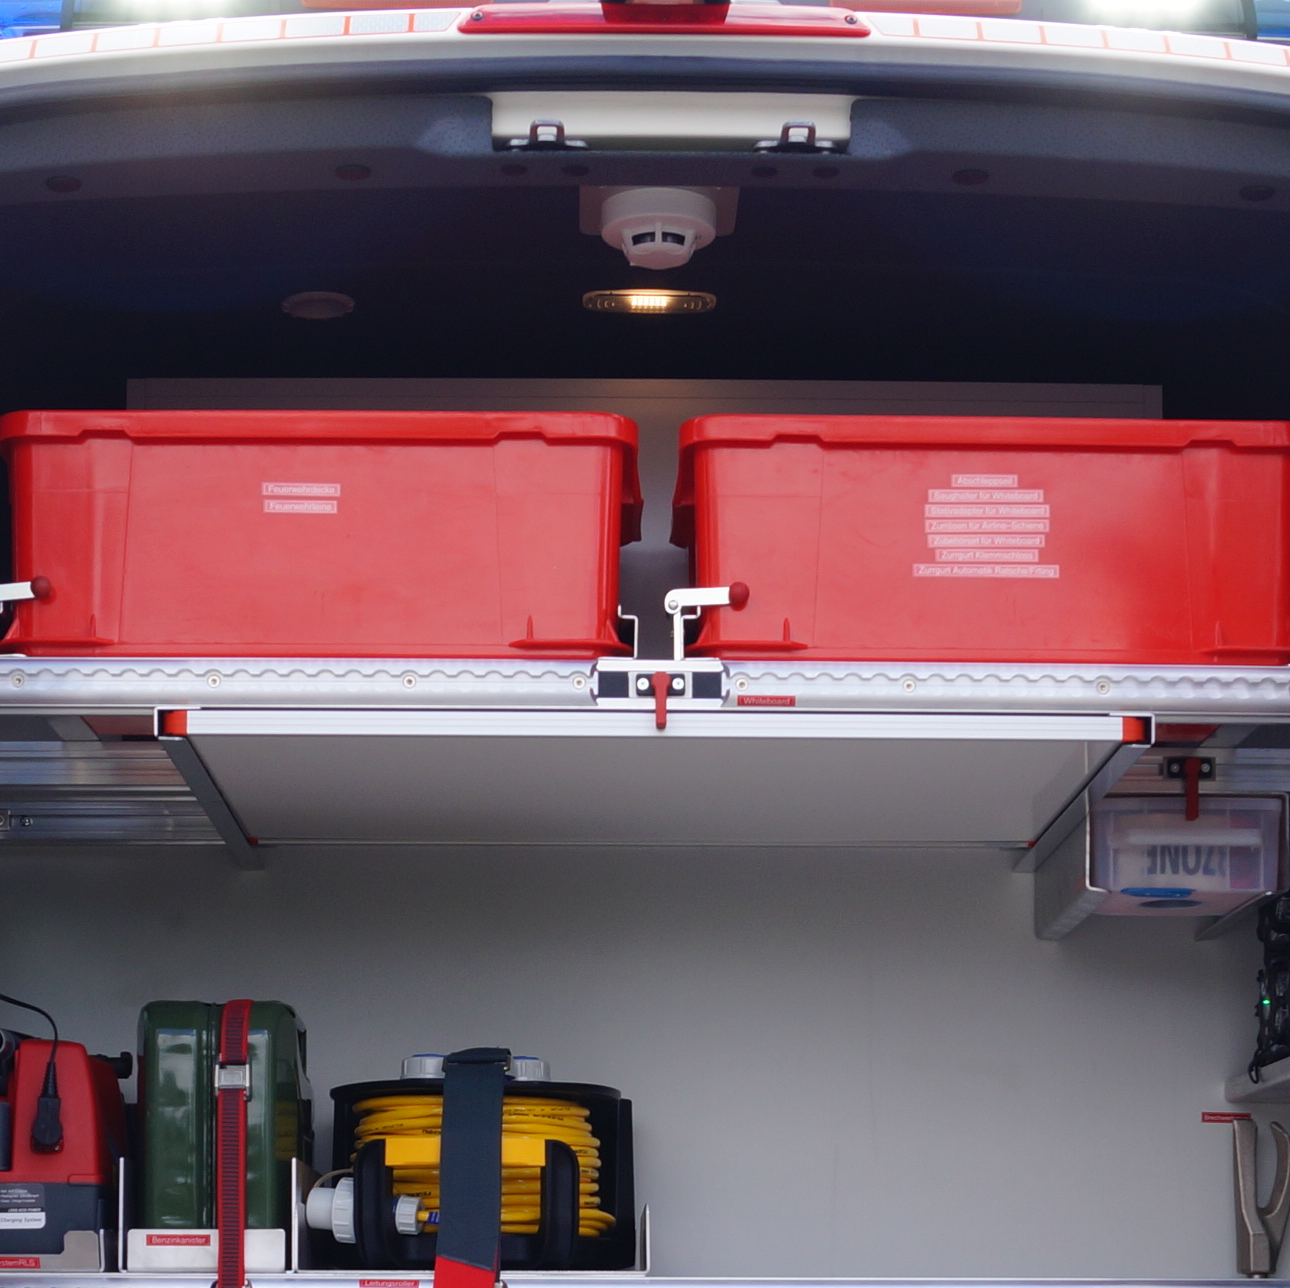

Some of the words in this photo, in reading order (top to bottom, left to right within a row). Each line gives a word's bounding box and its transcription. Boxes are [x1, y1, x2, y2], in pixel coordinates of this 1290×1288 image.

[957, 476, 1013, 487] Abschleppseil
[268, 485, 335, 494] Feuerwehrdecke
[993, 491, 1038, 501] Whiteboard
[269, 501, 332, 511] Feuerwehrleine
[999, 506, 1044, 516] Whiteboard
[994, 536, 1040, 546] Whiteboard
[743, 696, 791, 706] Whiteboard
[152, 1235, 206, 1246] Benzinkanister
[364, 1280, 415, 1288] Leitungsroller
